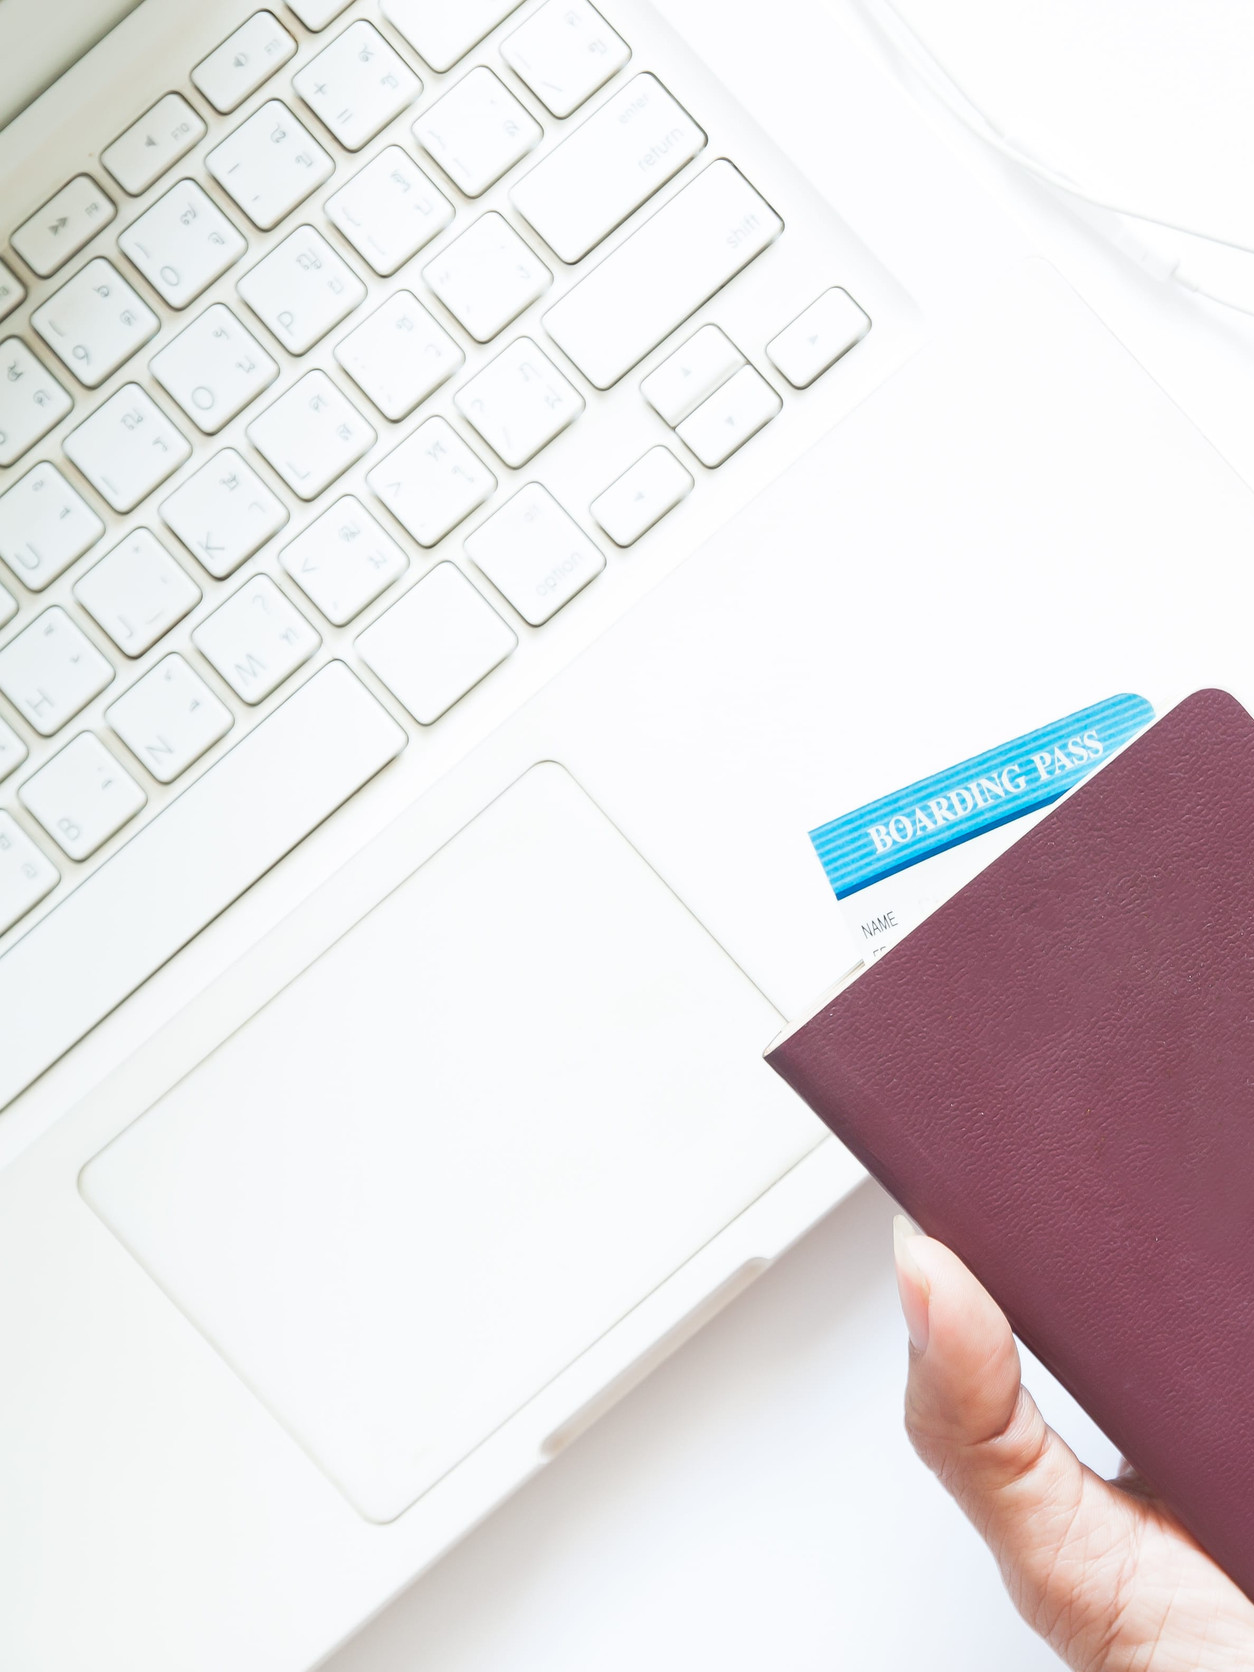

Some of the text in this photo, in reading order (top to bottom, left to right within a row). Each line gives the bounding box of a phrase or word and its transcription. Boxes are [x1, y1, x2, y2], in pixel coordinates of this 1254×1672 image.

[618, 93, 649, 125] enter
[170, 122, 190, 140] F10
[637, 127, 685, 172] return
[726, 213, 761, 249] shift
[277, 310, 295, 337] P
[73, 345, 90, 364] 9
[286, 461, 311, 480] L
[14, 542, 41, 570] U
[198, 531, 226, 558] K
[536, 551, 583, 597] option
[234, 653, 267, 681] M
[26, 688, 55, 717] H
[145, 735, 175, 764] N
[867, 730, 1104, 854] BOARDING PASS
[59, 818, 81, 840] B
[861, 911, 899, 939] NAME
